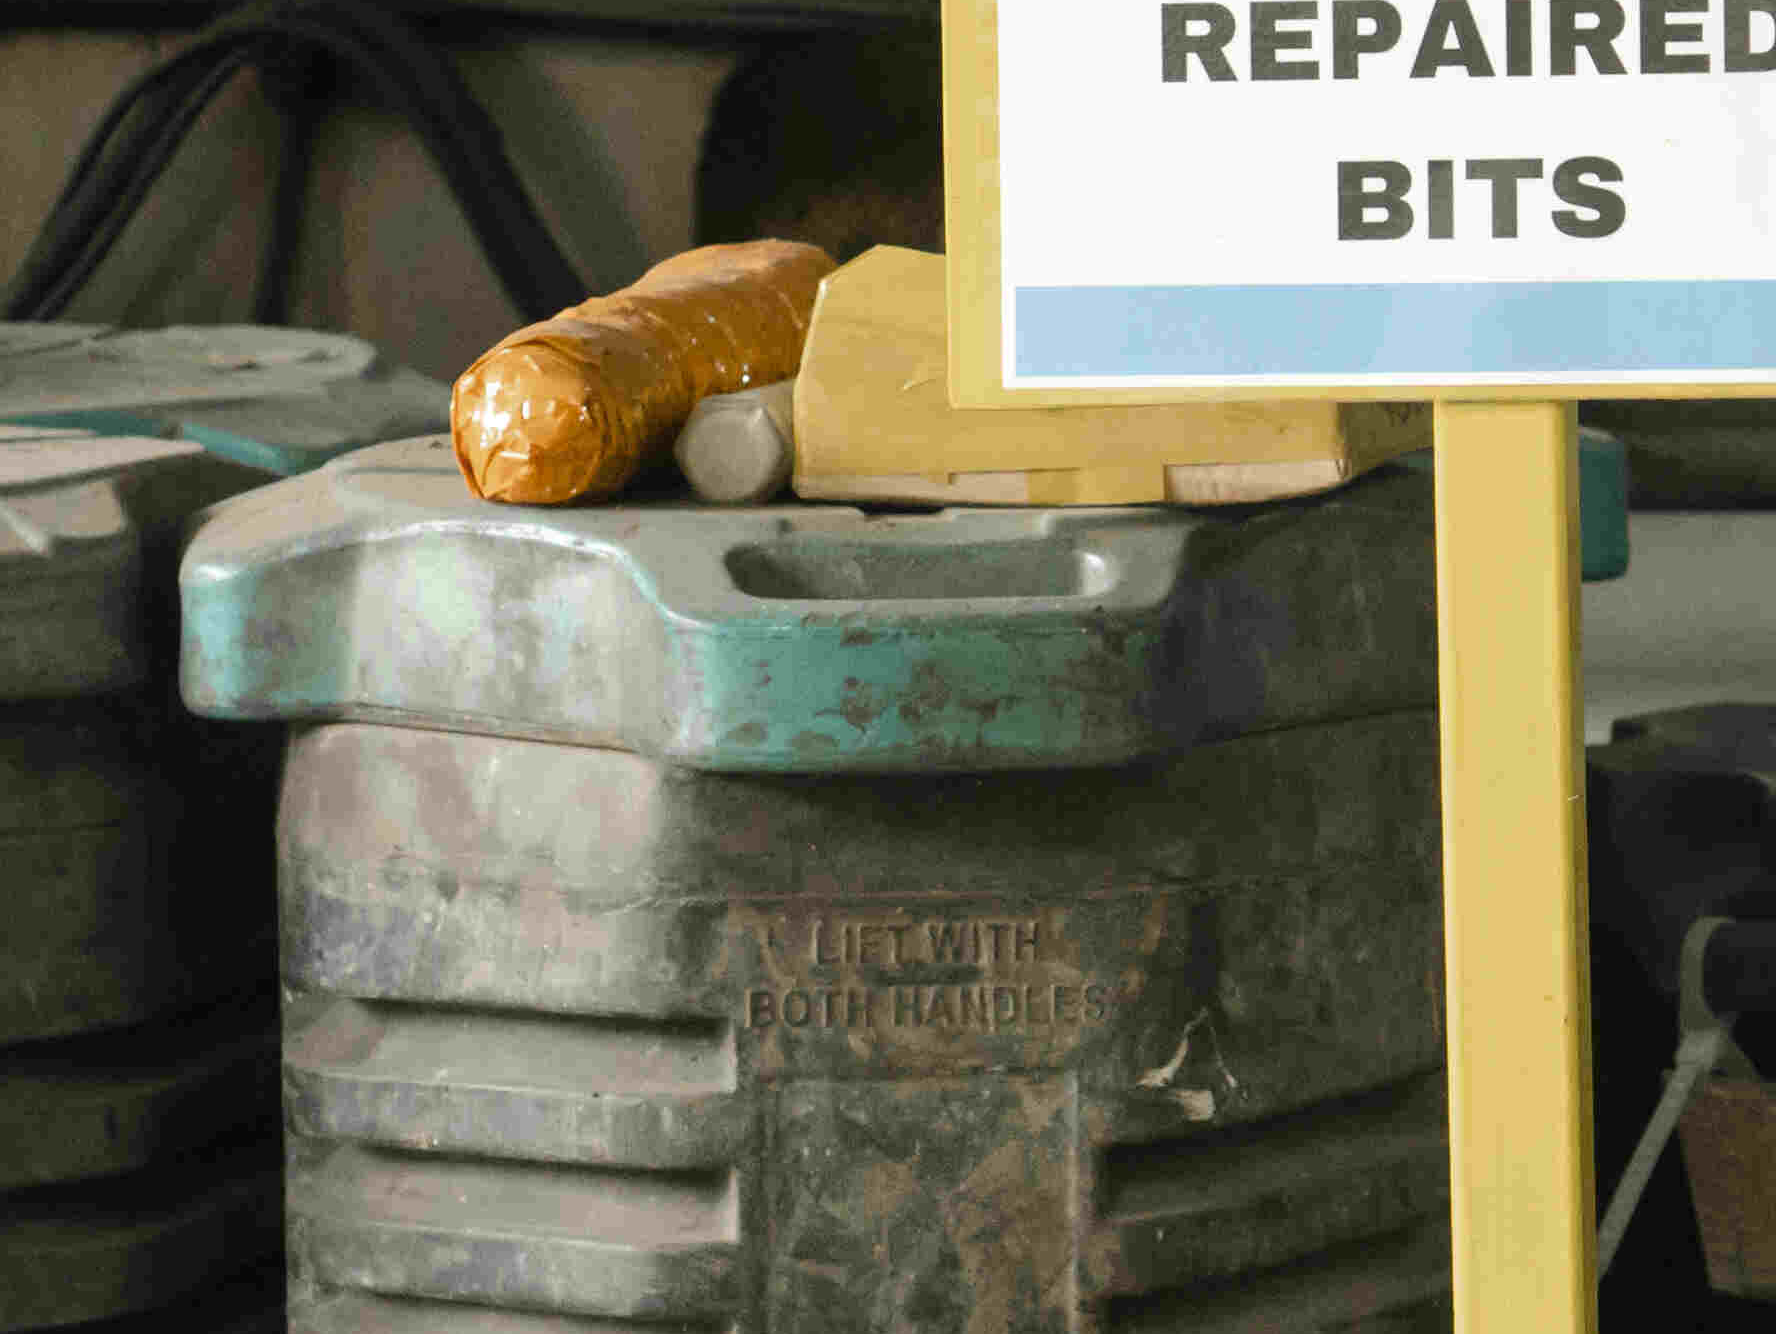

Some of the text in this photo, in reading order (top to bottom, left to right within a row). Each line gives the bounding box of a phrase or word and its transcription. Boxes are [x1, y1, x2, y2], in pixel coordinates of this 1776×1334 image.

[1338, 157, 1625, 240] BITS
[807, 919, 1041, 965] LIFT WITH
[744, 983, 1108, 1030] BOTH HANDLES
